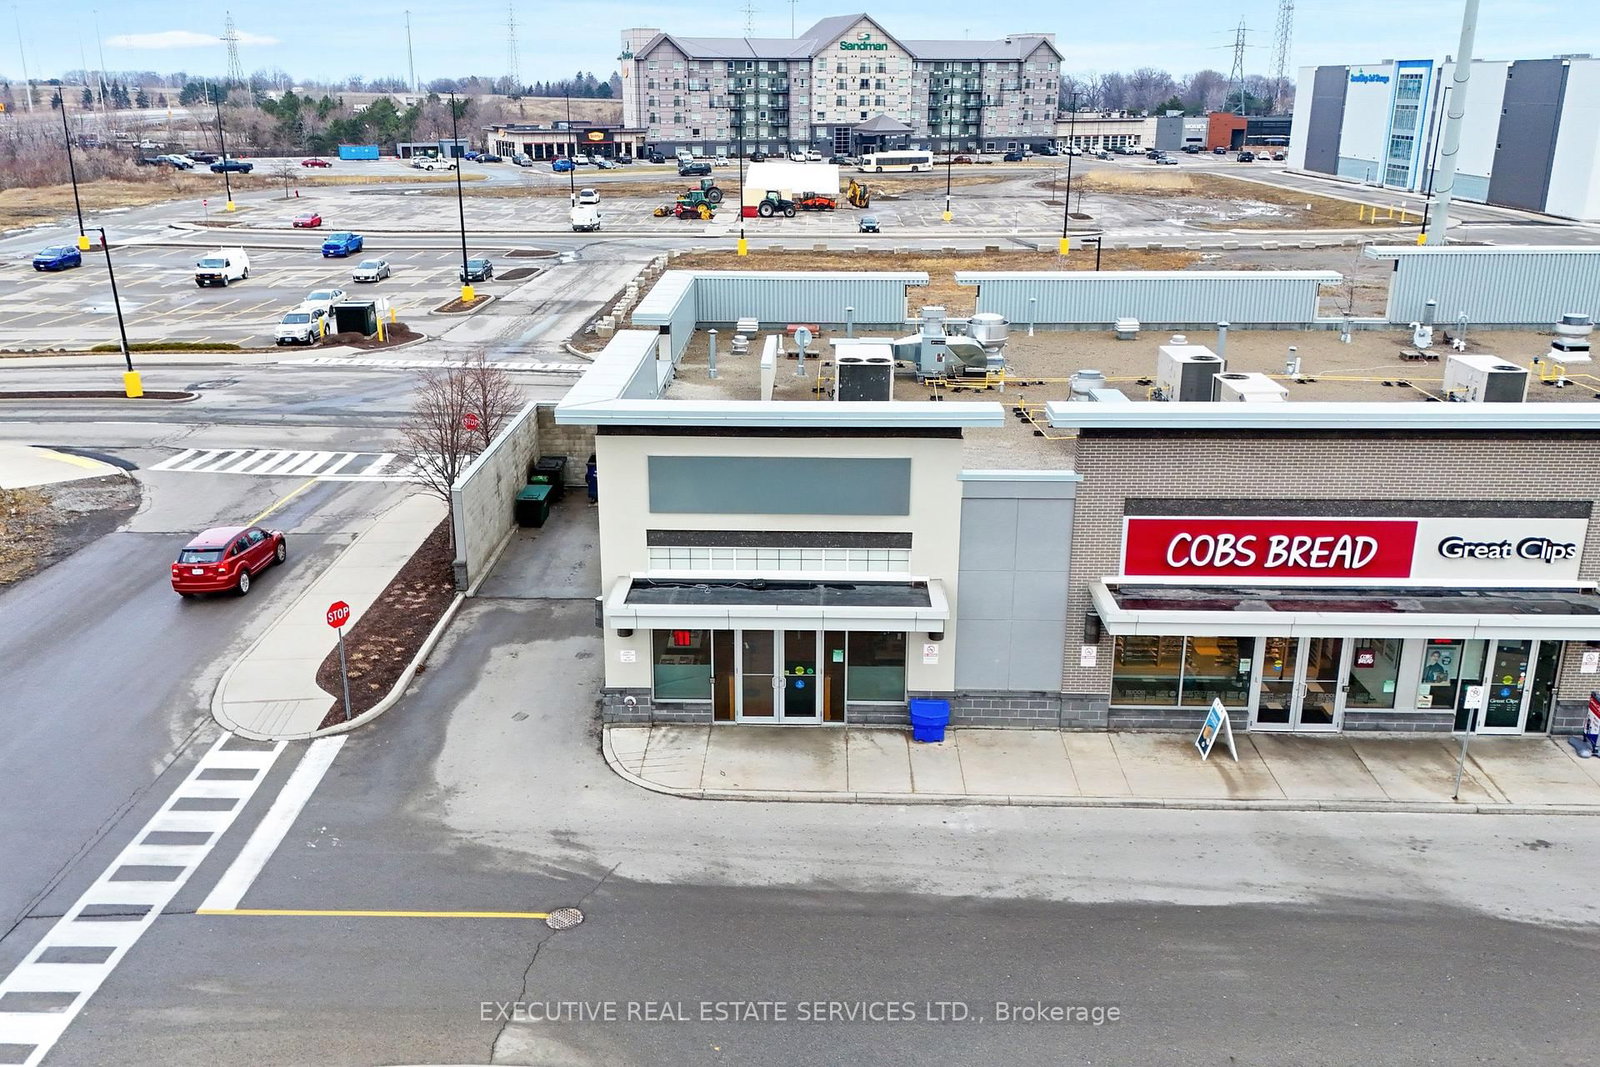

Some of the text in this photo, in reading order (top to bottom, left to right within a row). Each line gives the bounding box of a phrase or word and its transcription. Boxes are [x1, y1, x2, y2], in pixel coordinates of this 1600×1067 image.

[839, 41, 888, 51] Sandman
[1166, 532, 1378, 569] COBS BREAD
[1438, 536, 1576, 563] Great Clips
[328, 606, 349, 623] STOP
